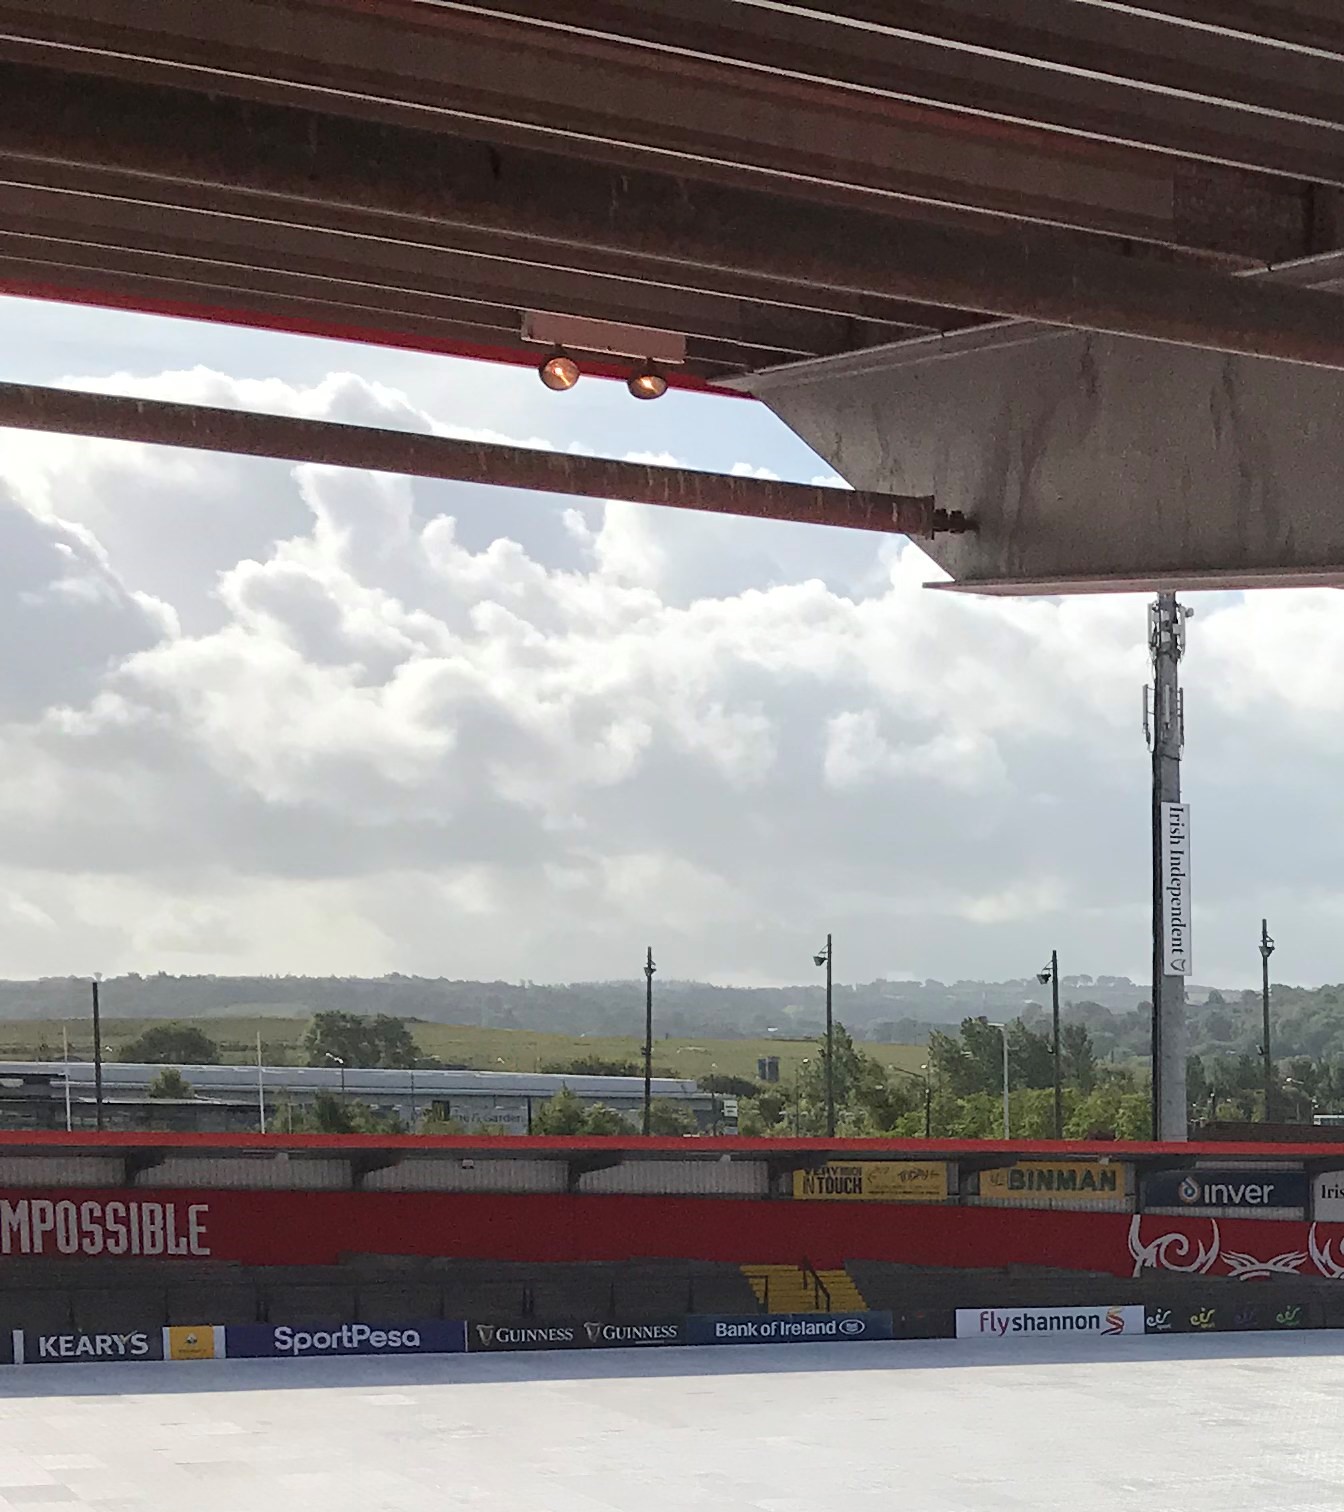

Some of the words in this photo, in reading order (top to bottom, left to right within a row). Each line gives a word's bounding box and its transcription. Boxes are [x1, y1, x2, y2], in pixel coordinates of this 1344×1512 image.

[1169, 807, 1185, 845] Irish
[1166, 849, 1187, 954] Independent
[803, 1176, 814, 1194] IN
[817, 1175, 862, 1194] TOUCH
[1008, 1169, 1116, 1191] BINMAN
[1204, 1184, 1275, 1204] inver
[979, 1311, 1100, 1337] flyshannon
[1146, 1308, 1171, 1326] eir
[1190, 1307, 1216, 1326] eir
[496, 1327, 574, 1343] GUINNESS
[603, 1325, 679, 1340] GUINNESS
[715, 1323, 758, 1337] Bank
[761, 1321, 778, 1336] of
[780, 1321, 836, 1336] Ireland
[274, 1324, 421, 1356] SportPesa
